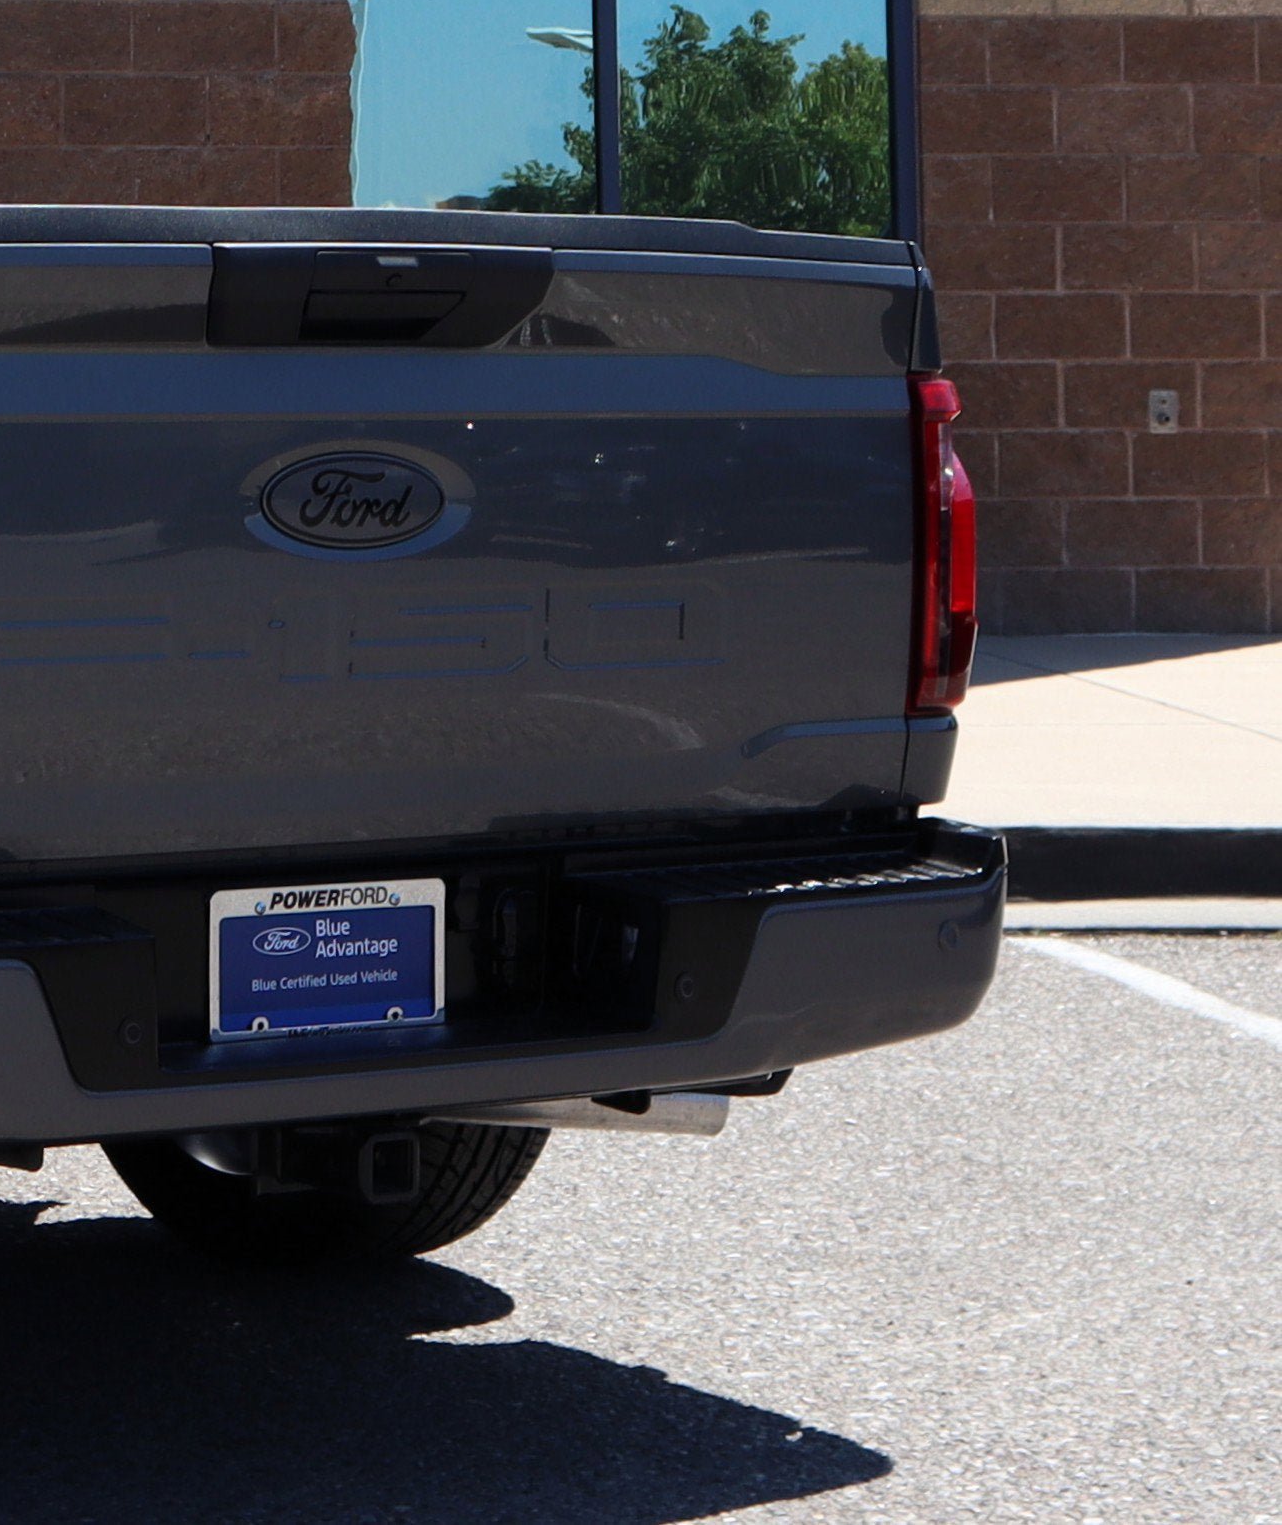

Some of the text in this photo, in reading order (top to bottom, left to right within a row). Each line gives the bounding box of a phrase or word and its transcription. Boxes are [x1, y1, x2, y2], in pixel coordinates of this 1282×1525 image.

[298, 467, 413, 529] Ford
[269, 886, 388, 910] POWERFORD
[315, 918, 351, 937] Blue
[263, 931, 299, 951] Ford
[314, 937, 398, 958] Advantage
[251, 968, 398, 992] Blue Certified Used Vehicle
